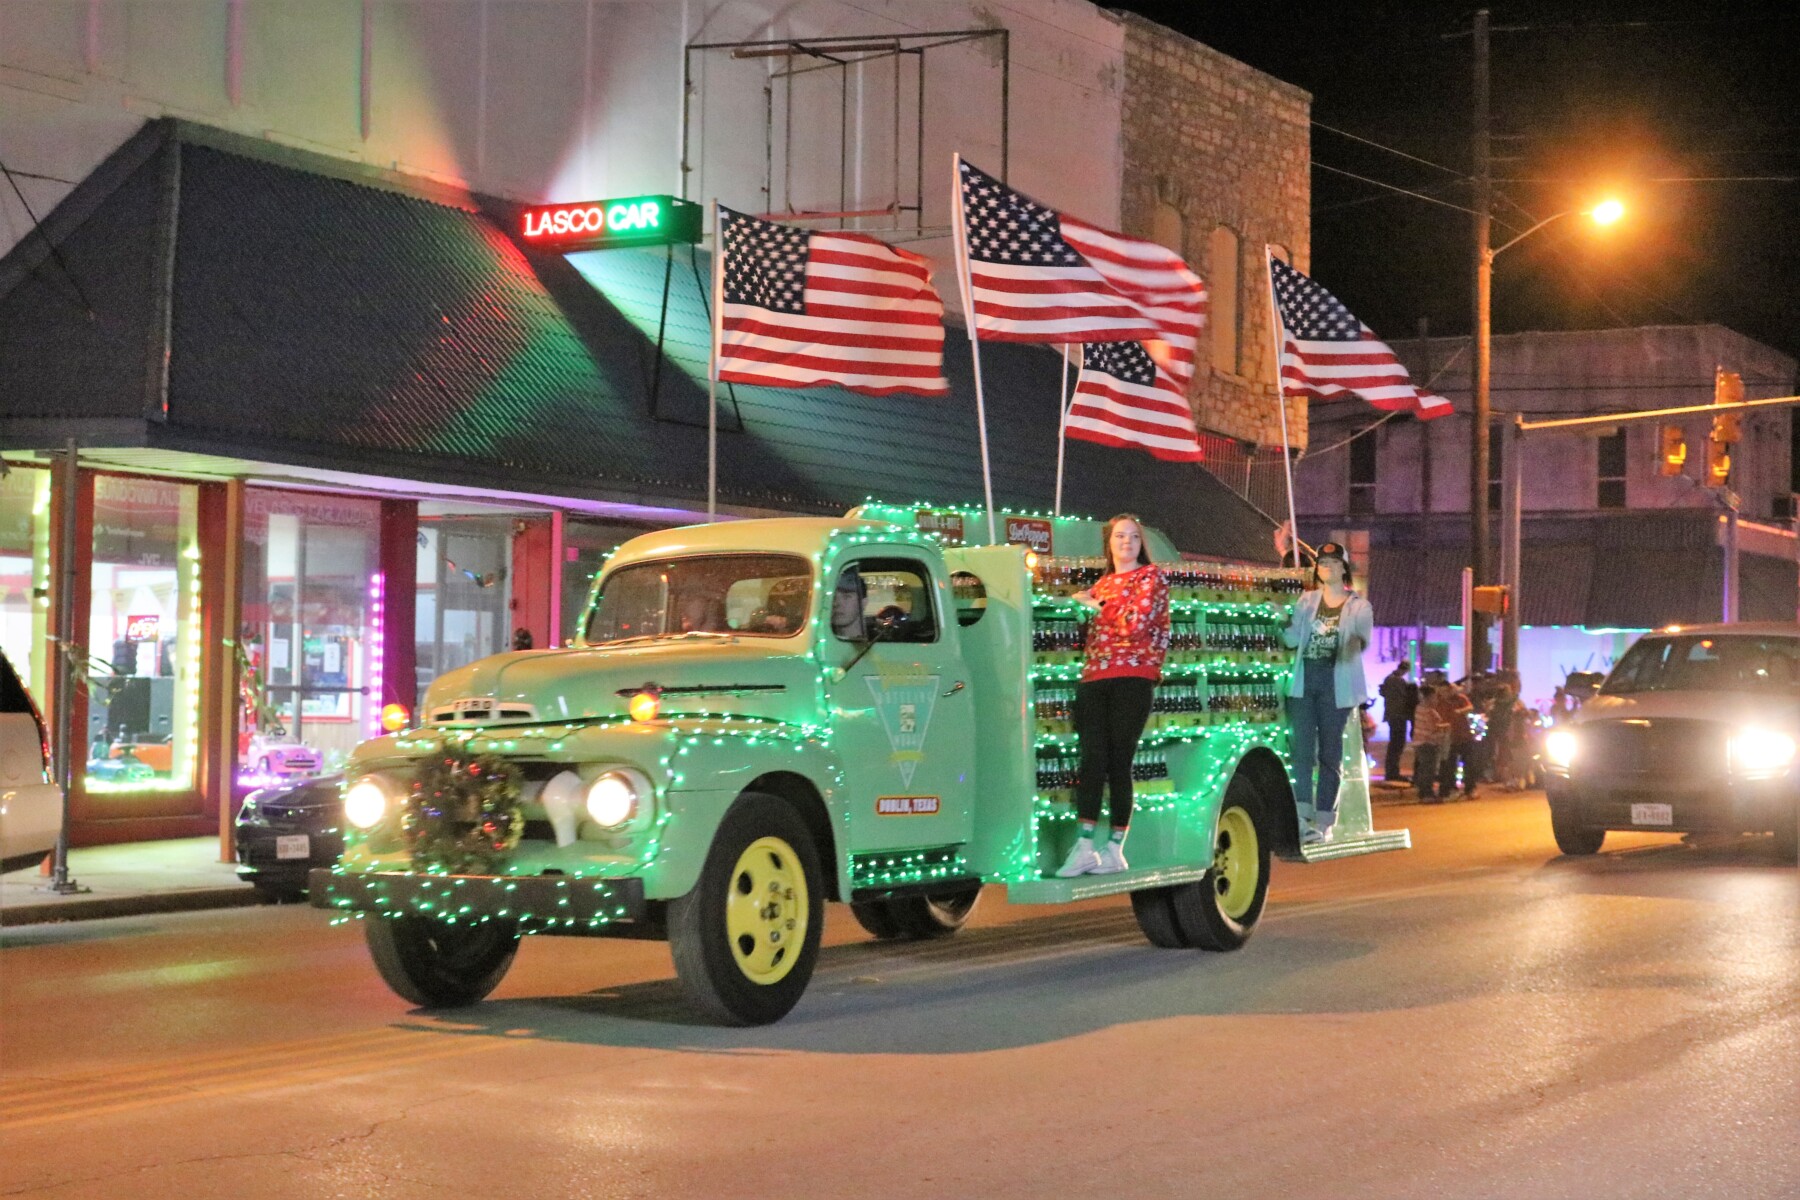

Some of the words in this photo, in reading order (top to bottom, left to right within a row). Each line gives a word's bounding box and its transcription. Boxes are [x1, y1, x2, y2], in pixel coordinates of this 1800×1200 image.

[524, 207, 603, 237] LASCO
[607, 202, 659, 231] CAR
[138, 552, 161, 566] JVC
